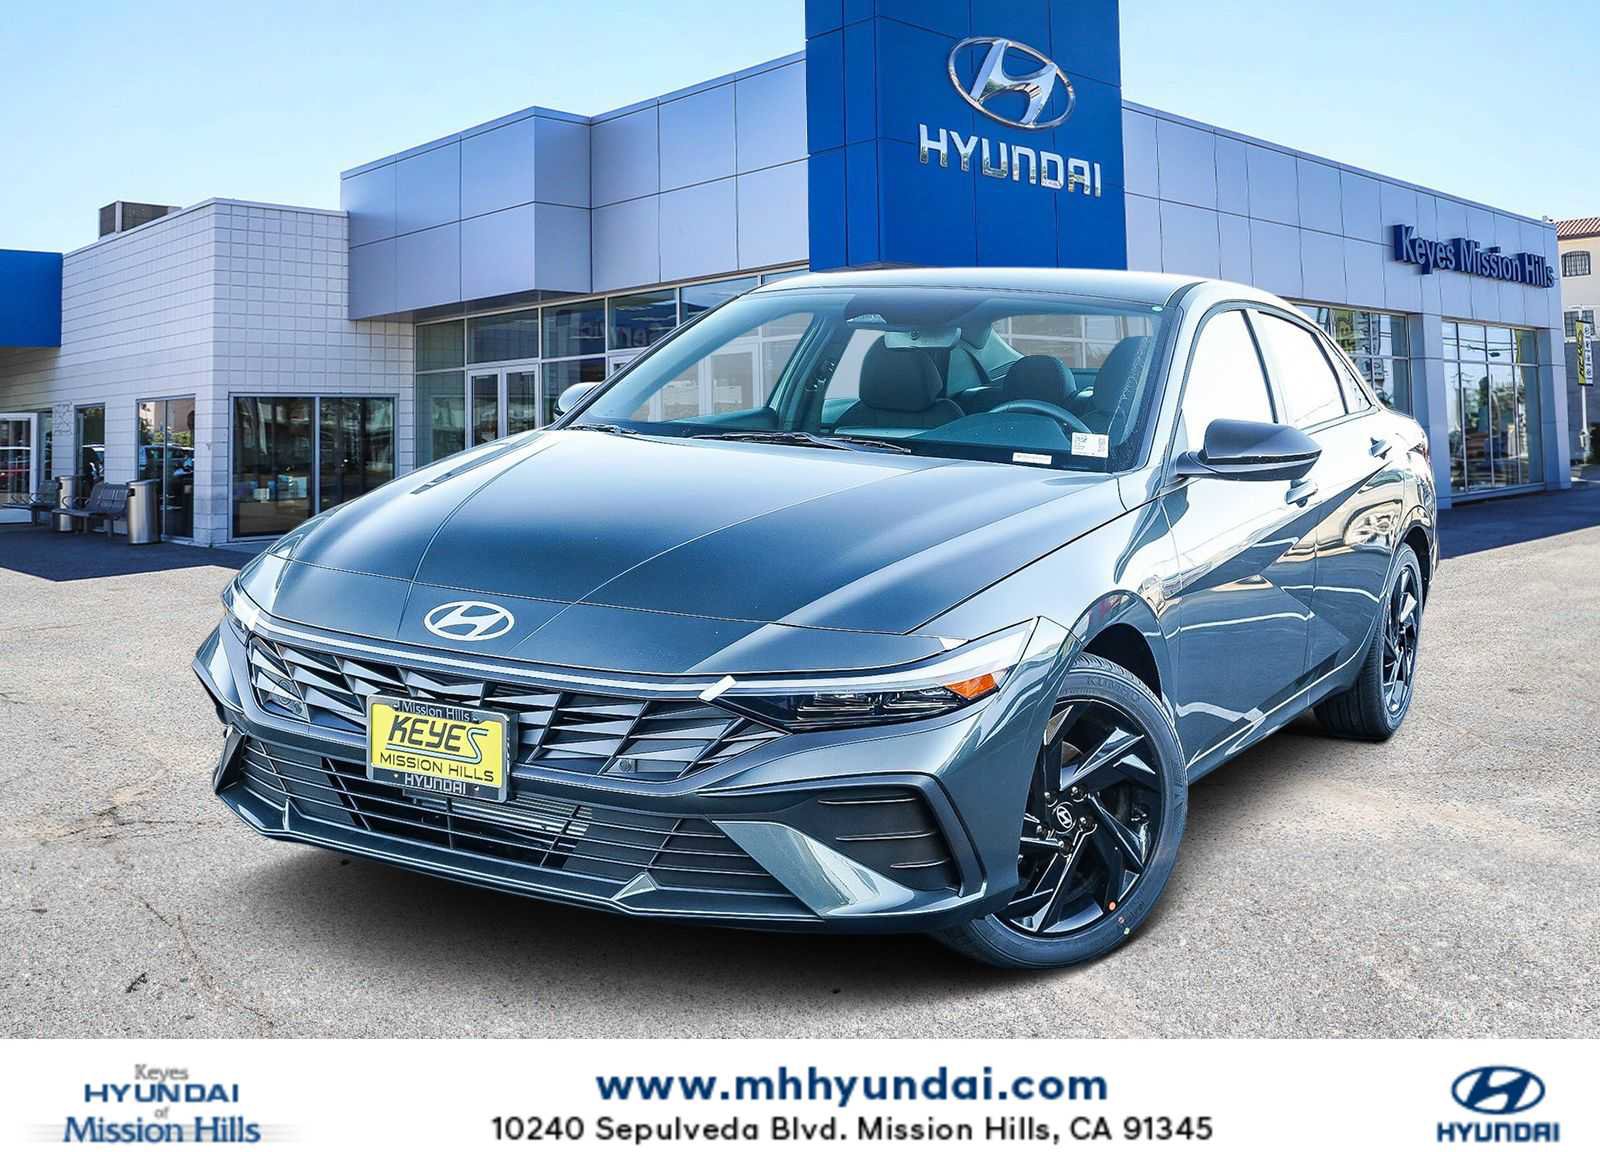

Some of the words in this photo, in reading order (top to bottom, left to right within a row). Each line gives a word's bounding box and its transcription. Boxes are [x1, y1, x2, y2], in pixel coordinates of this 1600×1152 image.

[919, 124, 1102, 197] HYUNDAI
[1396, 224, 1455, 274] Keyes
[1458, 238, 1521, 282] Mission
[1523, 253, 1555, 288] Hills
[402, 701, 443, 718] Mission
[446, 708, 471, 723] Hills
[387, 715, 489, 765] KEYES
[380, 752, 443, 774] MISSION
[448, 764, 495, 783] HILLS
[404, 774, 467, 795] HYUNDAI
